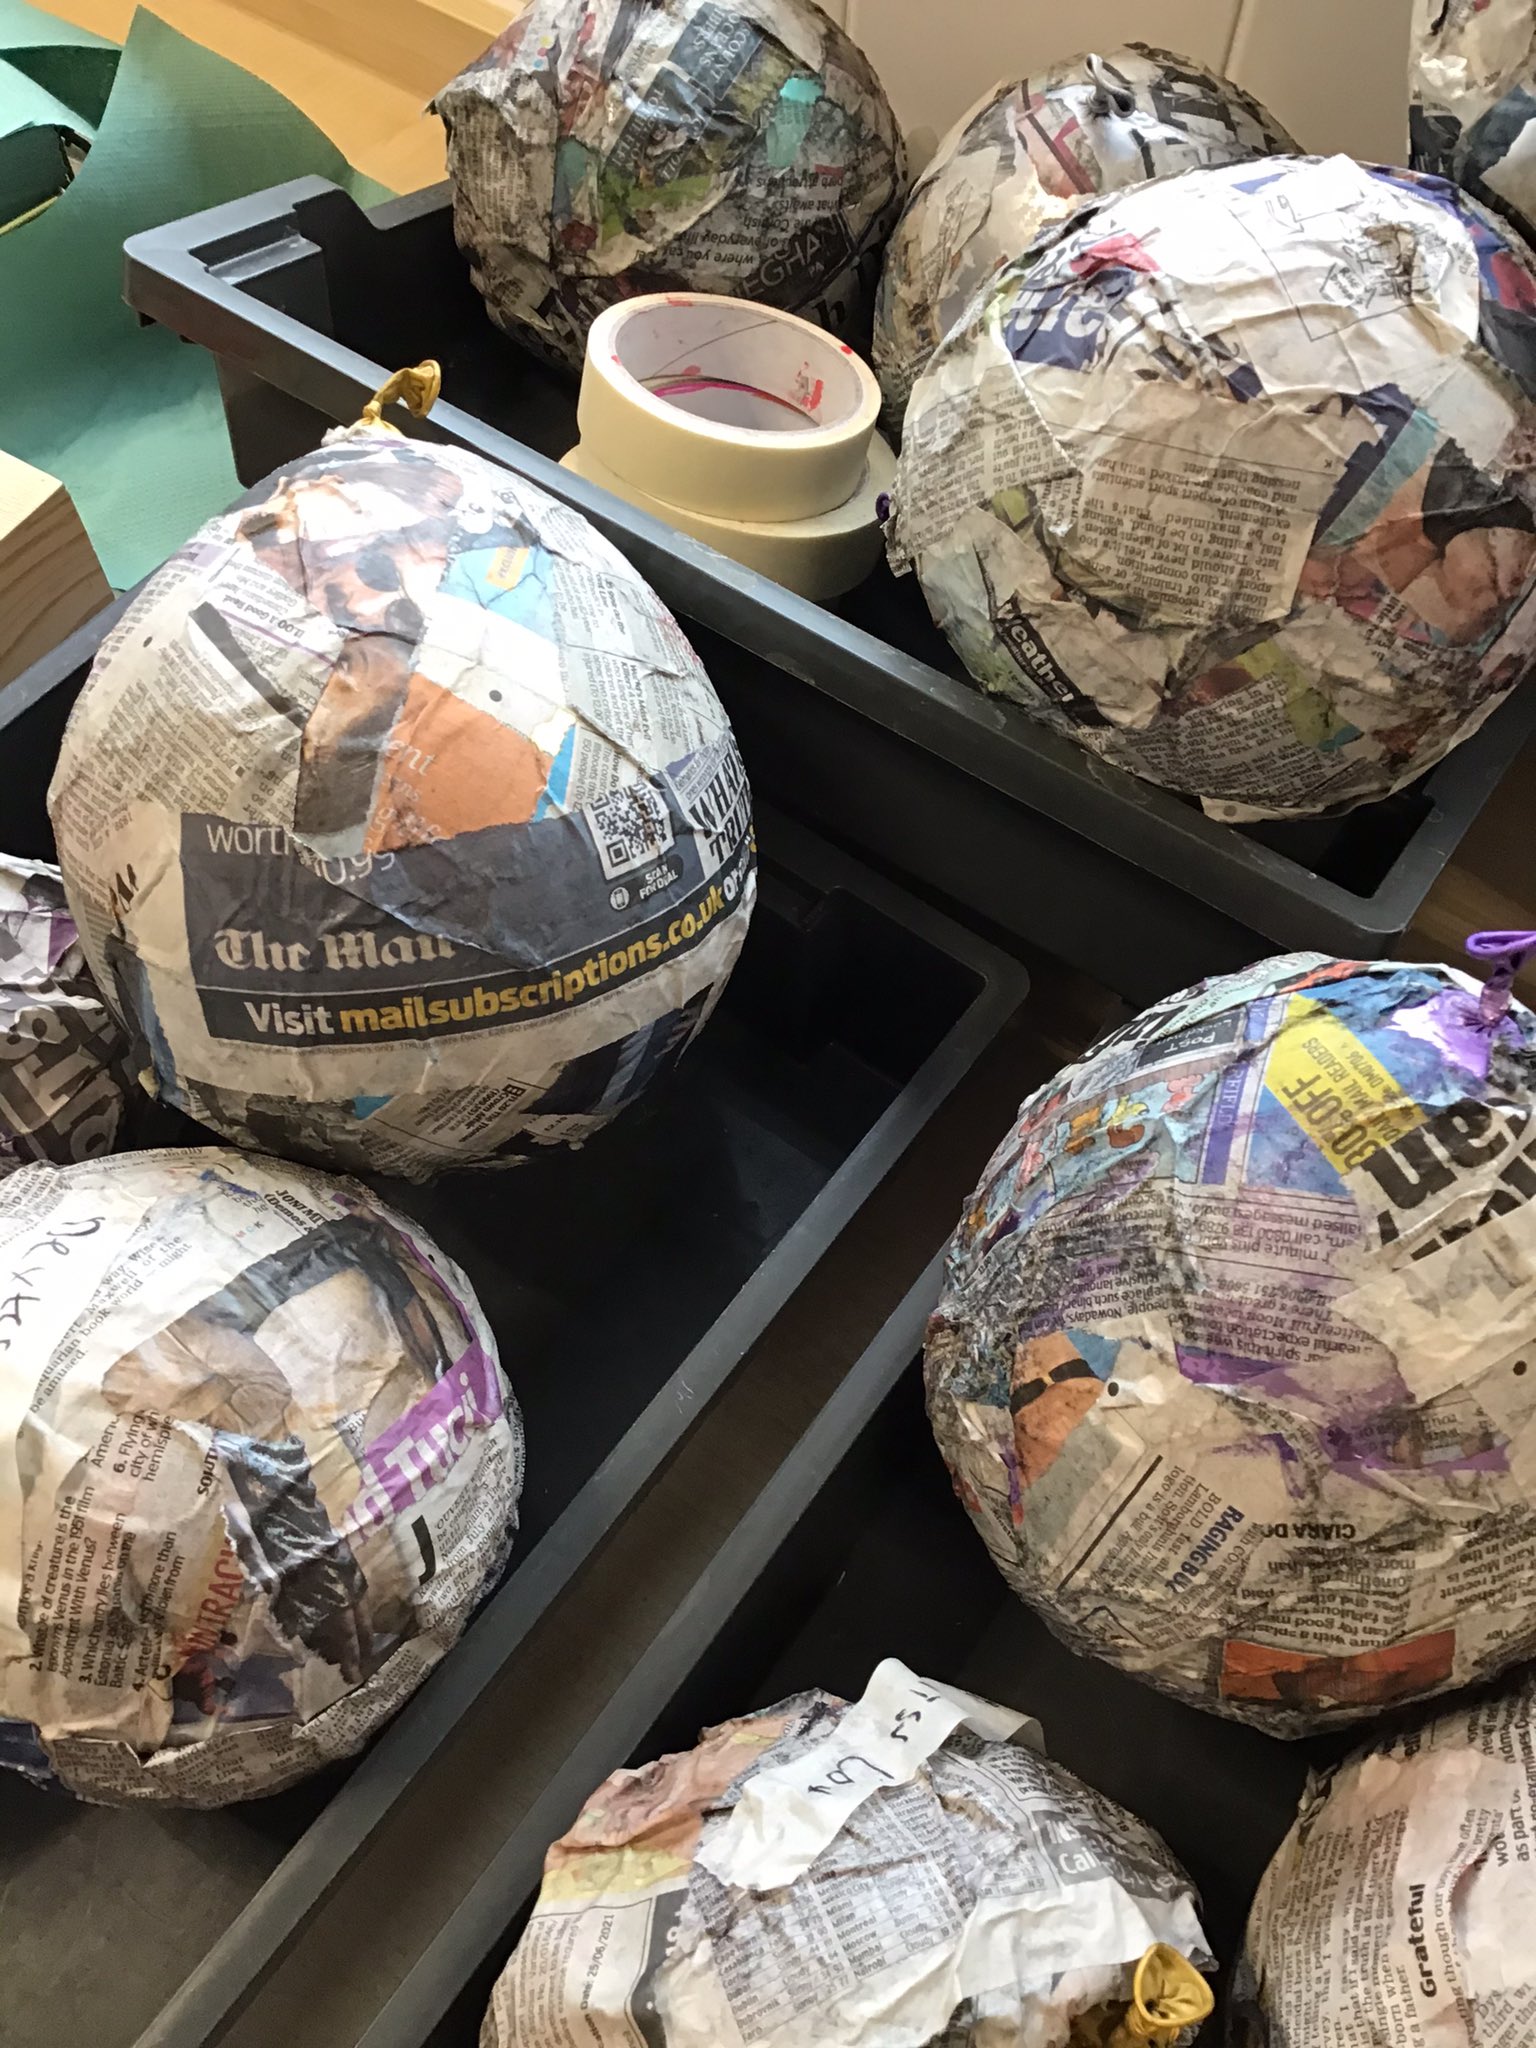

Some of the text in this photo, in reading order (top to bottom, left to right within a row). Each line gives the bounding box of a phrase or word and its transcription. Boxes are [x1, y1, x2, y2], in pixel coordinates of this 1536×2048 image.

[243, 1001, 335, 1036] Visit
[1302, 1034, 1349, 1084] READERS
[1283, 1068, 1342, 1127] OFF
[111, 1457, 127, 1474] 6.
[127, 1449, 149, 1479] city
[44, 1534, 65, 1594] creature
[53, 1582, 70, 1620] Venus
[77, 1485, 93, 1512] film
[76, 1536, 96, 1583] Venus?
[105, 1511, 124, 1570] between
[1188, 1504, 1244, 1568] RAGING
[1407, 1884, 1438, 1999] Grateful
